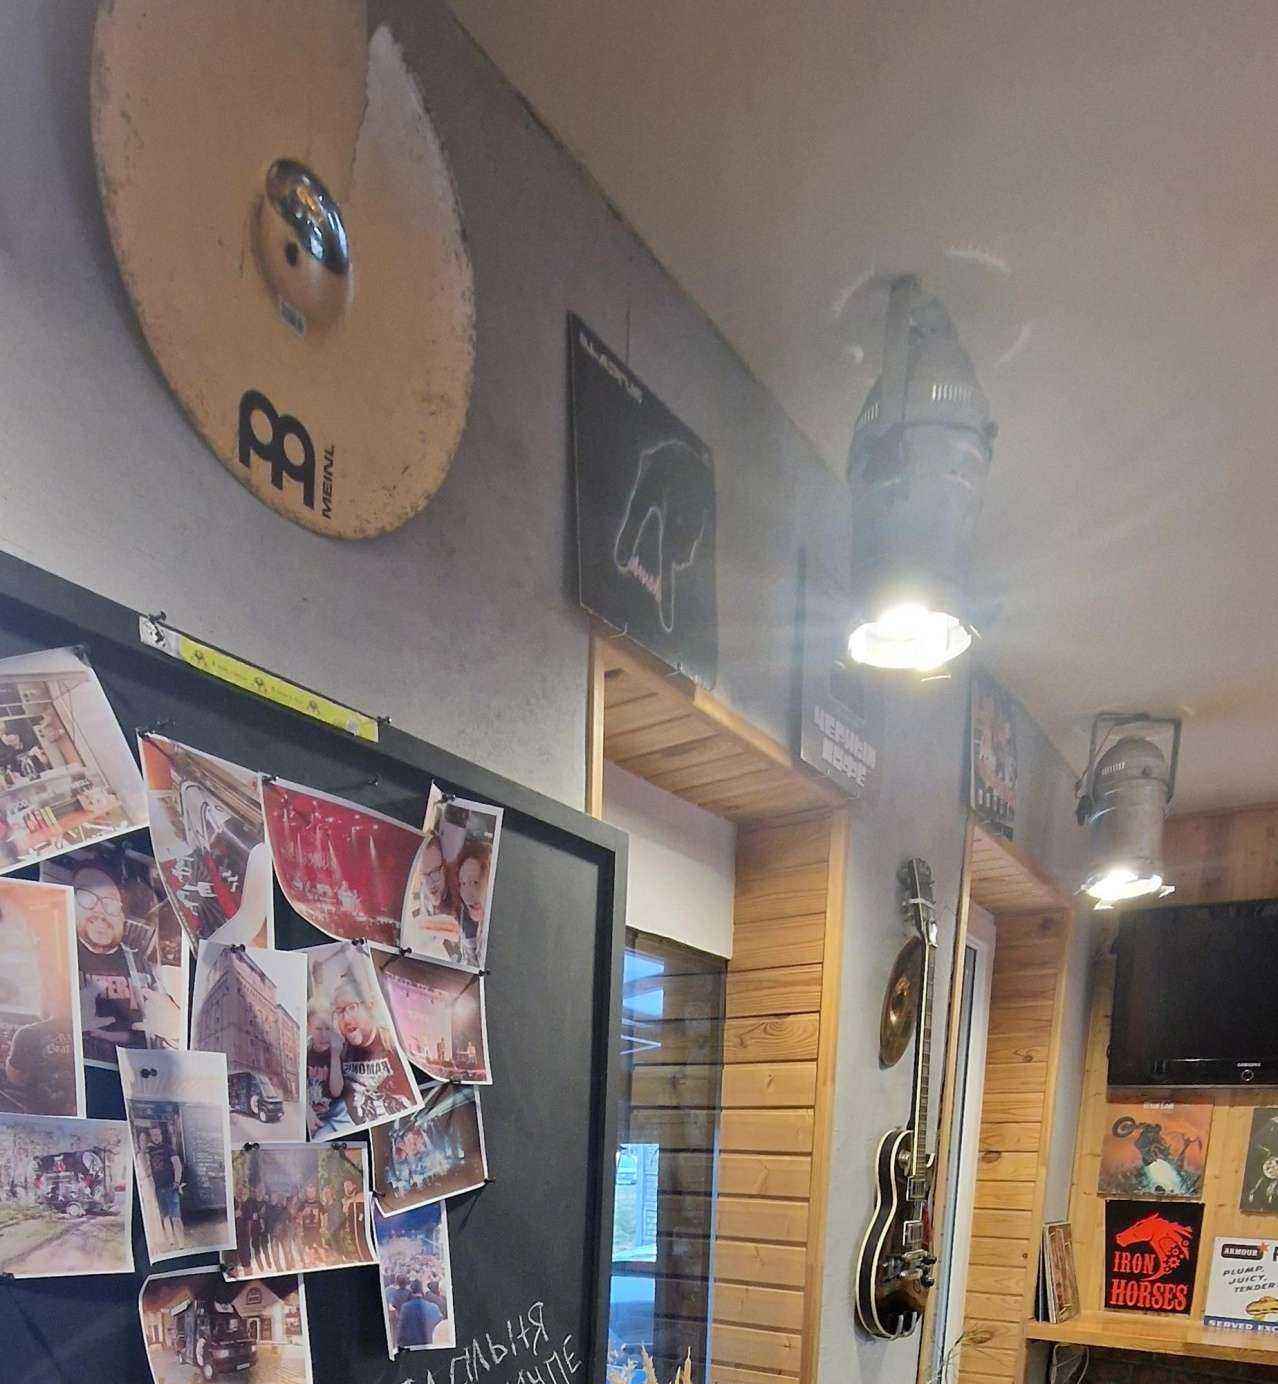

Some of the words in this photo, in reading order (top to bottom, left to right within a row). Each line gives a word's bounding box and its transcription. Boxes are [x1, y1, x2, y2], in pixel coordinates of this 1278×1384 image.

[321, 444, 336, 520] MEINL
[1112, 1251, 1156, 1275] IRON
[1223, 1246, 1259, 1258] ARMOUR
[1222, 1265, 1266, 1278] PLUMP,
[1109, 1278, 1189, 1312] HORSES
